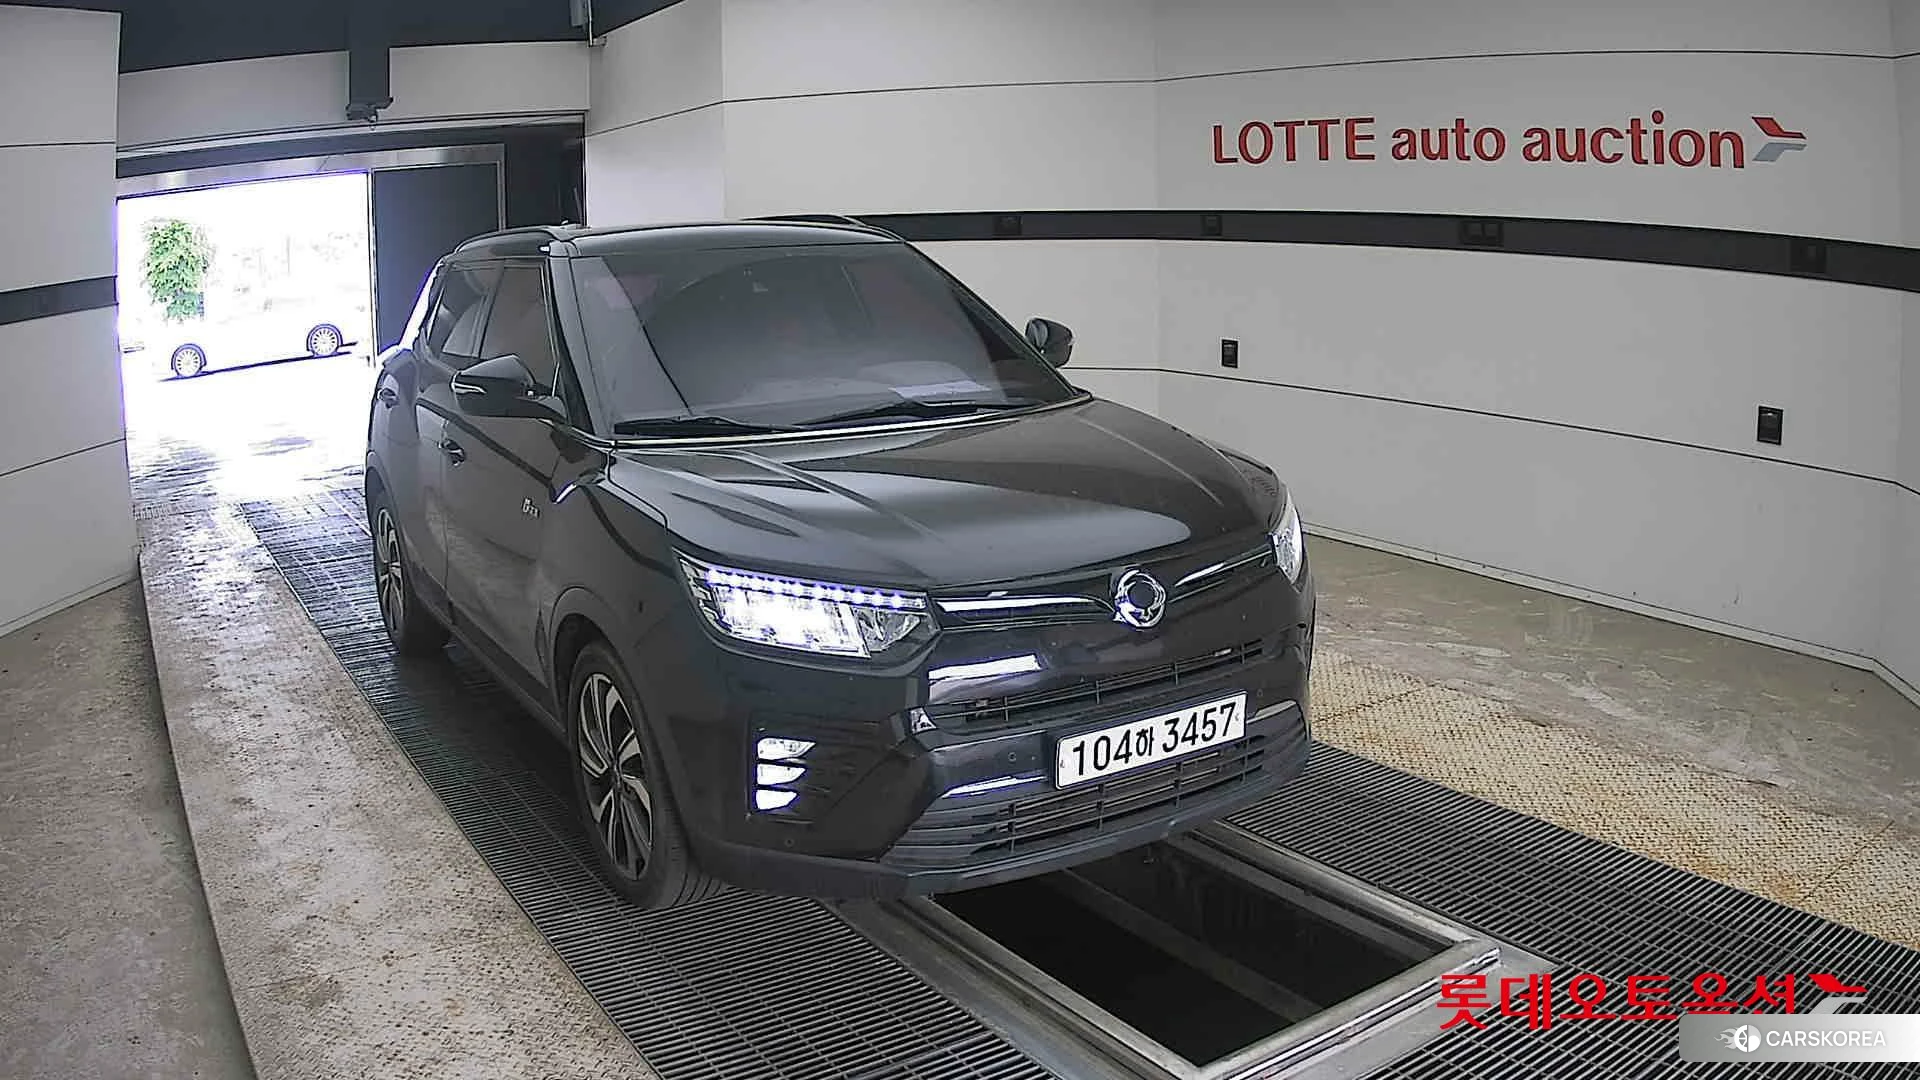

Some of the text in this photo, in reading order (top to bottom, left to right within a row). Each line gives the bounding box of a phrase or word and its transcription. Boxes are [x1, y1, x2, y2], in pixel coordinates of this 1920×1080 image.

[1212, 109, 1746, 169] LOTTE auto auction
[1072, 702, 1236, 776] 104하 3457
